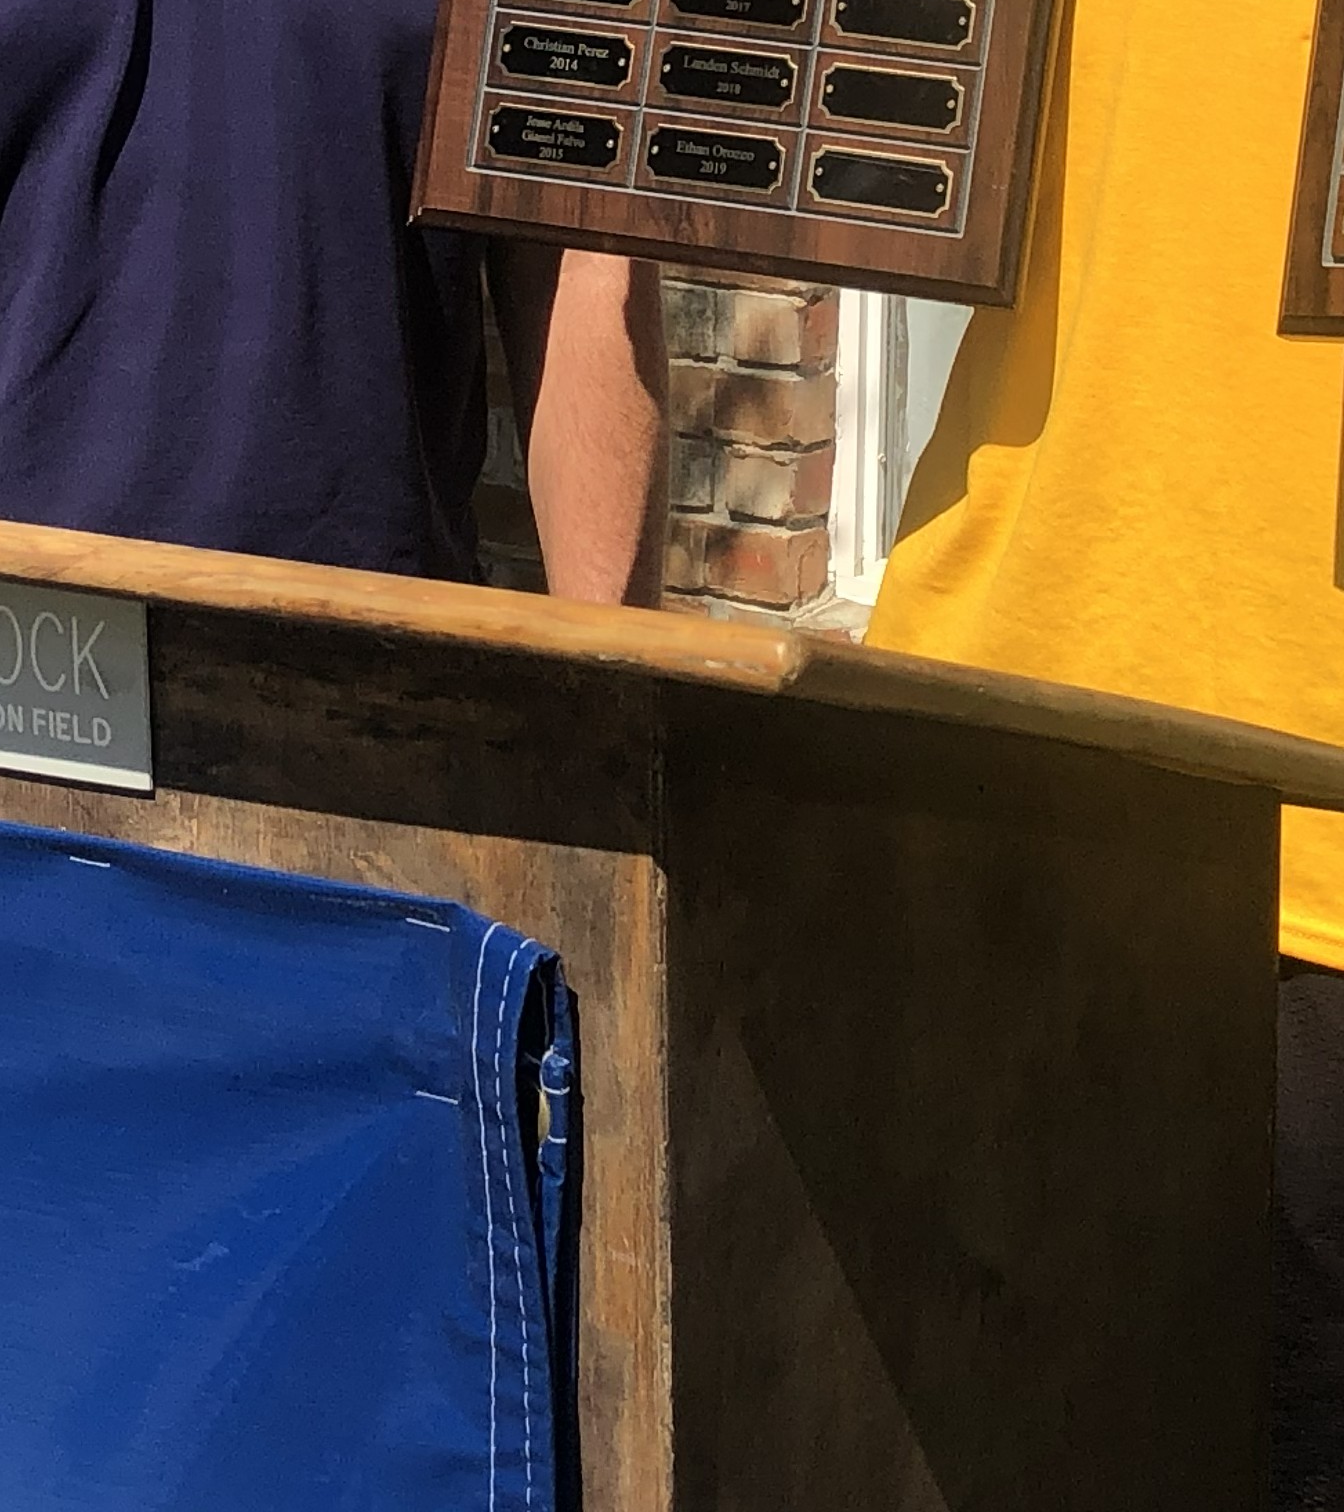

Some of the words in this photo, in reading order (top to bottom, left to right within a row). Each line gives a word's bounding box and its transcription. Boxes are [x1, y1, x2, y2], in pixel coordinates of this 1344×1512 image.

[725, 0, 752, 13] 2017
[523, 36, 575, 55] Christian
[577, 43, 610, 59] Perez
[549, 56, 578, 71] 2014
[731, 61, 781, 79] Schmidt
[538, 146, 564, 160] 2015
[676, 140, 710, 156] Ethan
[699, 159, 728, 175] 2019
[32, 708, 113, 748] FIELD
